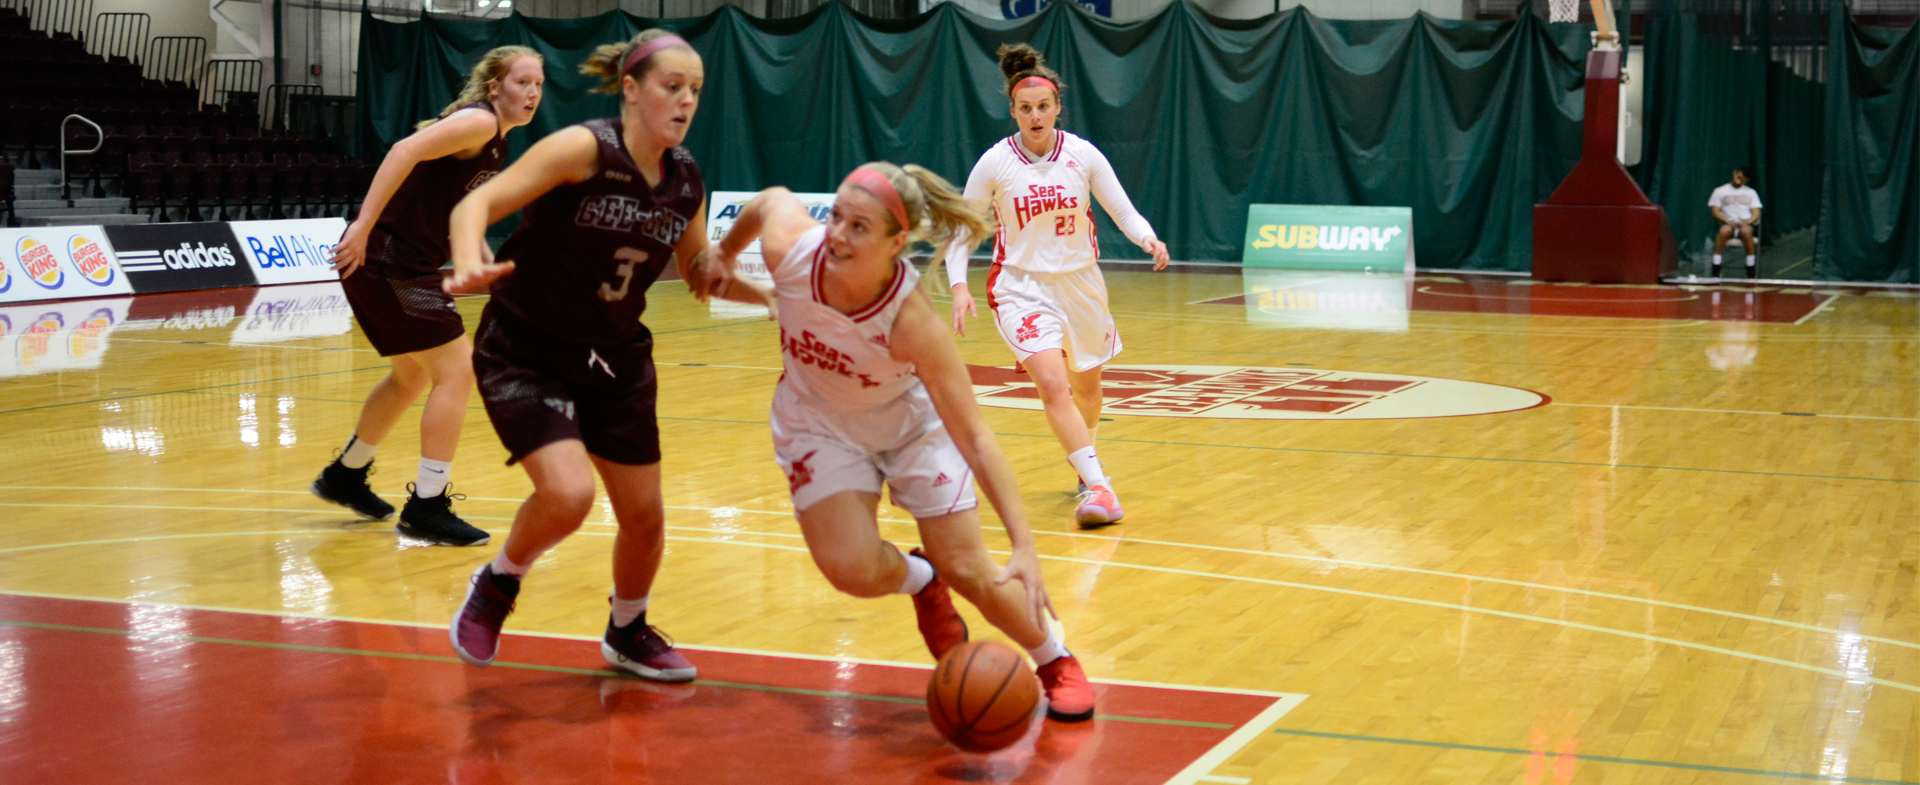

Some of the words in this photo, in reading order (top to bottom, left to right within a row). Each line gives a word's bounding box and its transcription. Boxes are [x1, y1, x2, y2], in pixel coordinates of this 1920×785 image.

[1029, 184, 1066, 199] Sea-
[1013, 192, 1078, 232] Hawks
[1055, 214, 1076, 237] 23
[1252, 225, 1402, 251] SUBWAY
[21, 245, 50, 266] BURGER
[72, 243, 101, 264] BURGER
[79, 252, 108, 277] KING
[163, 242, 236, 270] adidas
[28, 254, 58, 280] KING
[598, 247, 649, 301] 3
